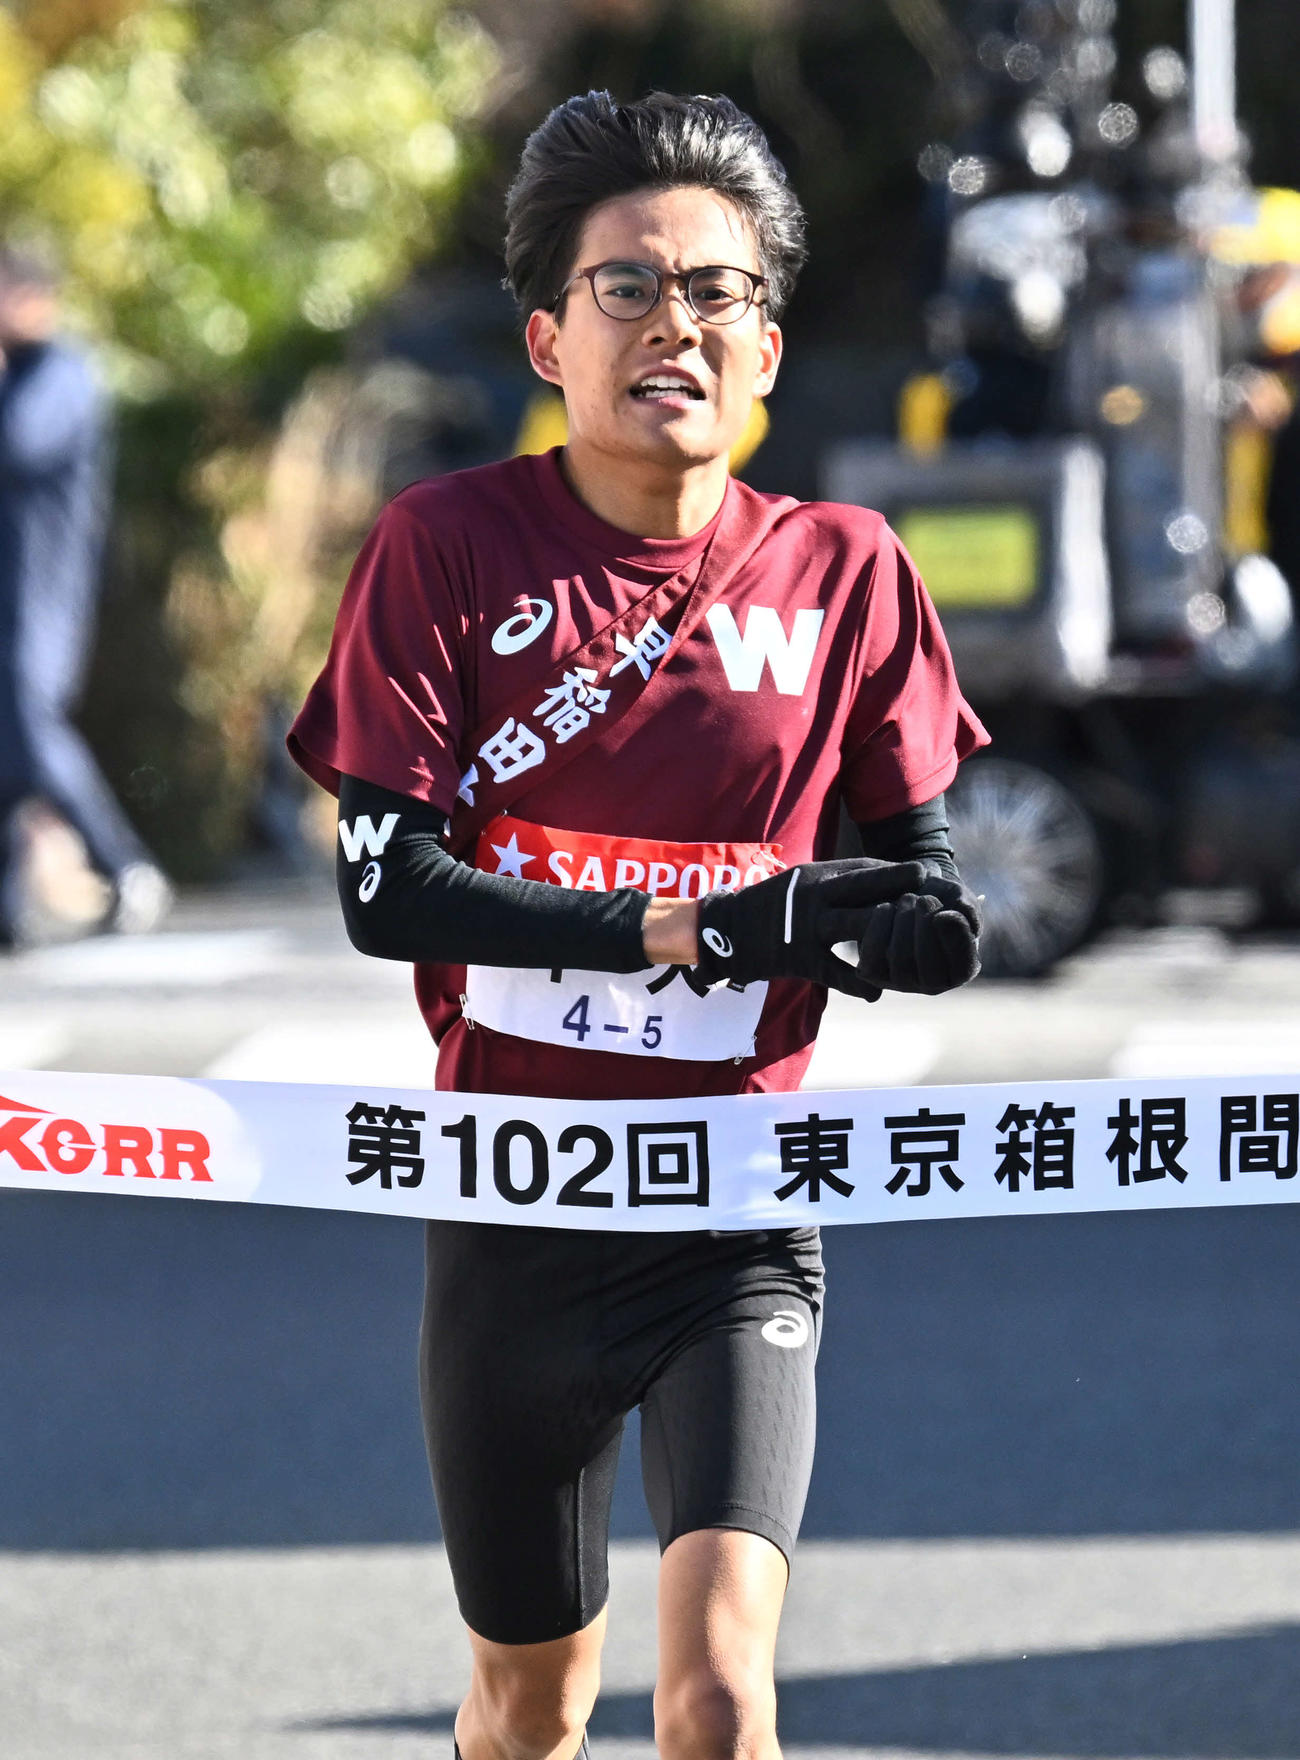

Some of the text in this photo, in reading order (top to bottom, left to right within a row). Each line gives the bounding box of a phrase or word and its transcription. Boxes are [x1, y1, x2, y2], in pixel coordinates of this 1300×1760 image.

[706, 603, 825, 696] W
[338, 813, 401, 862] W
[344, 1093, 1300, 1208] 第102回 東京箱根間
